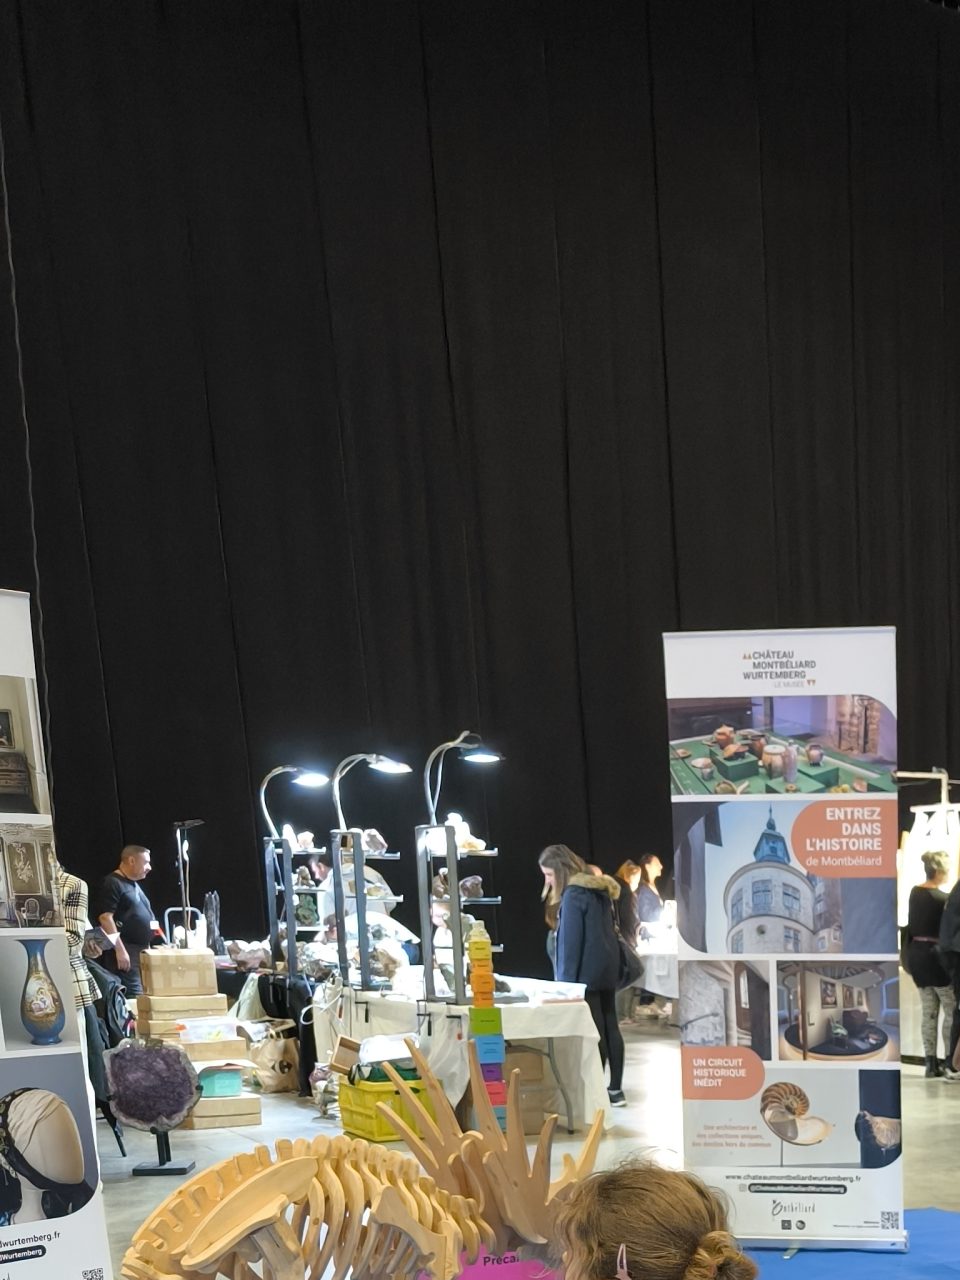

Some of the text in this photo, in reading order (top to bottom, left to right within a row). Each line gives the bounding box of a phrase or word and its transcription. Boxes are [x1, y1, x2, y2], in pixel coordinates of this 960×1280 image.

[752, 649, 794, 660] CHÂTEAU
[752, 659, 816, 670] MONTBÉLIARD
[743, 670, 806, 680] WURTEMBERG
[826, 807, 881, 820] ENTREZ
[842, 822, 881, 835] DANS
[806, 838, 882, 851] L'HISTOIRE
[806, 856, 882, 866] de Montbéliard
[693, 1058, 743, 1067] UN CIRCUIT
[693, 1068, 747, 1077] HISTORIQUE
[694, 1078, 722, 1087] INÉDIT
